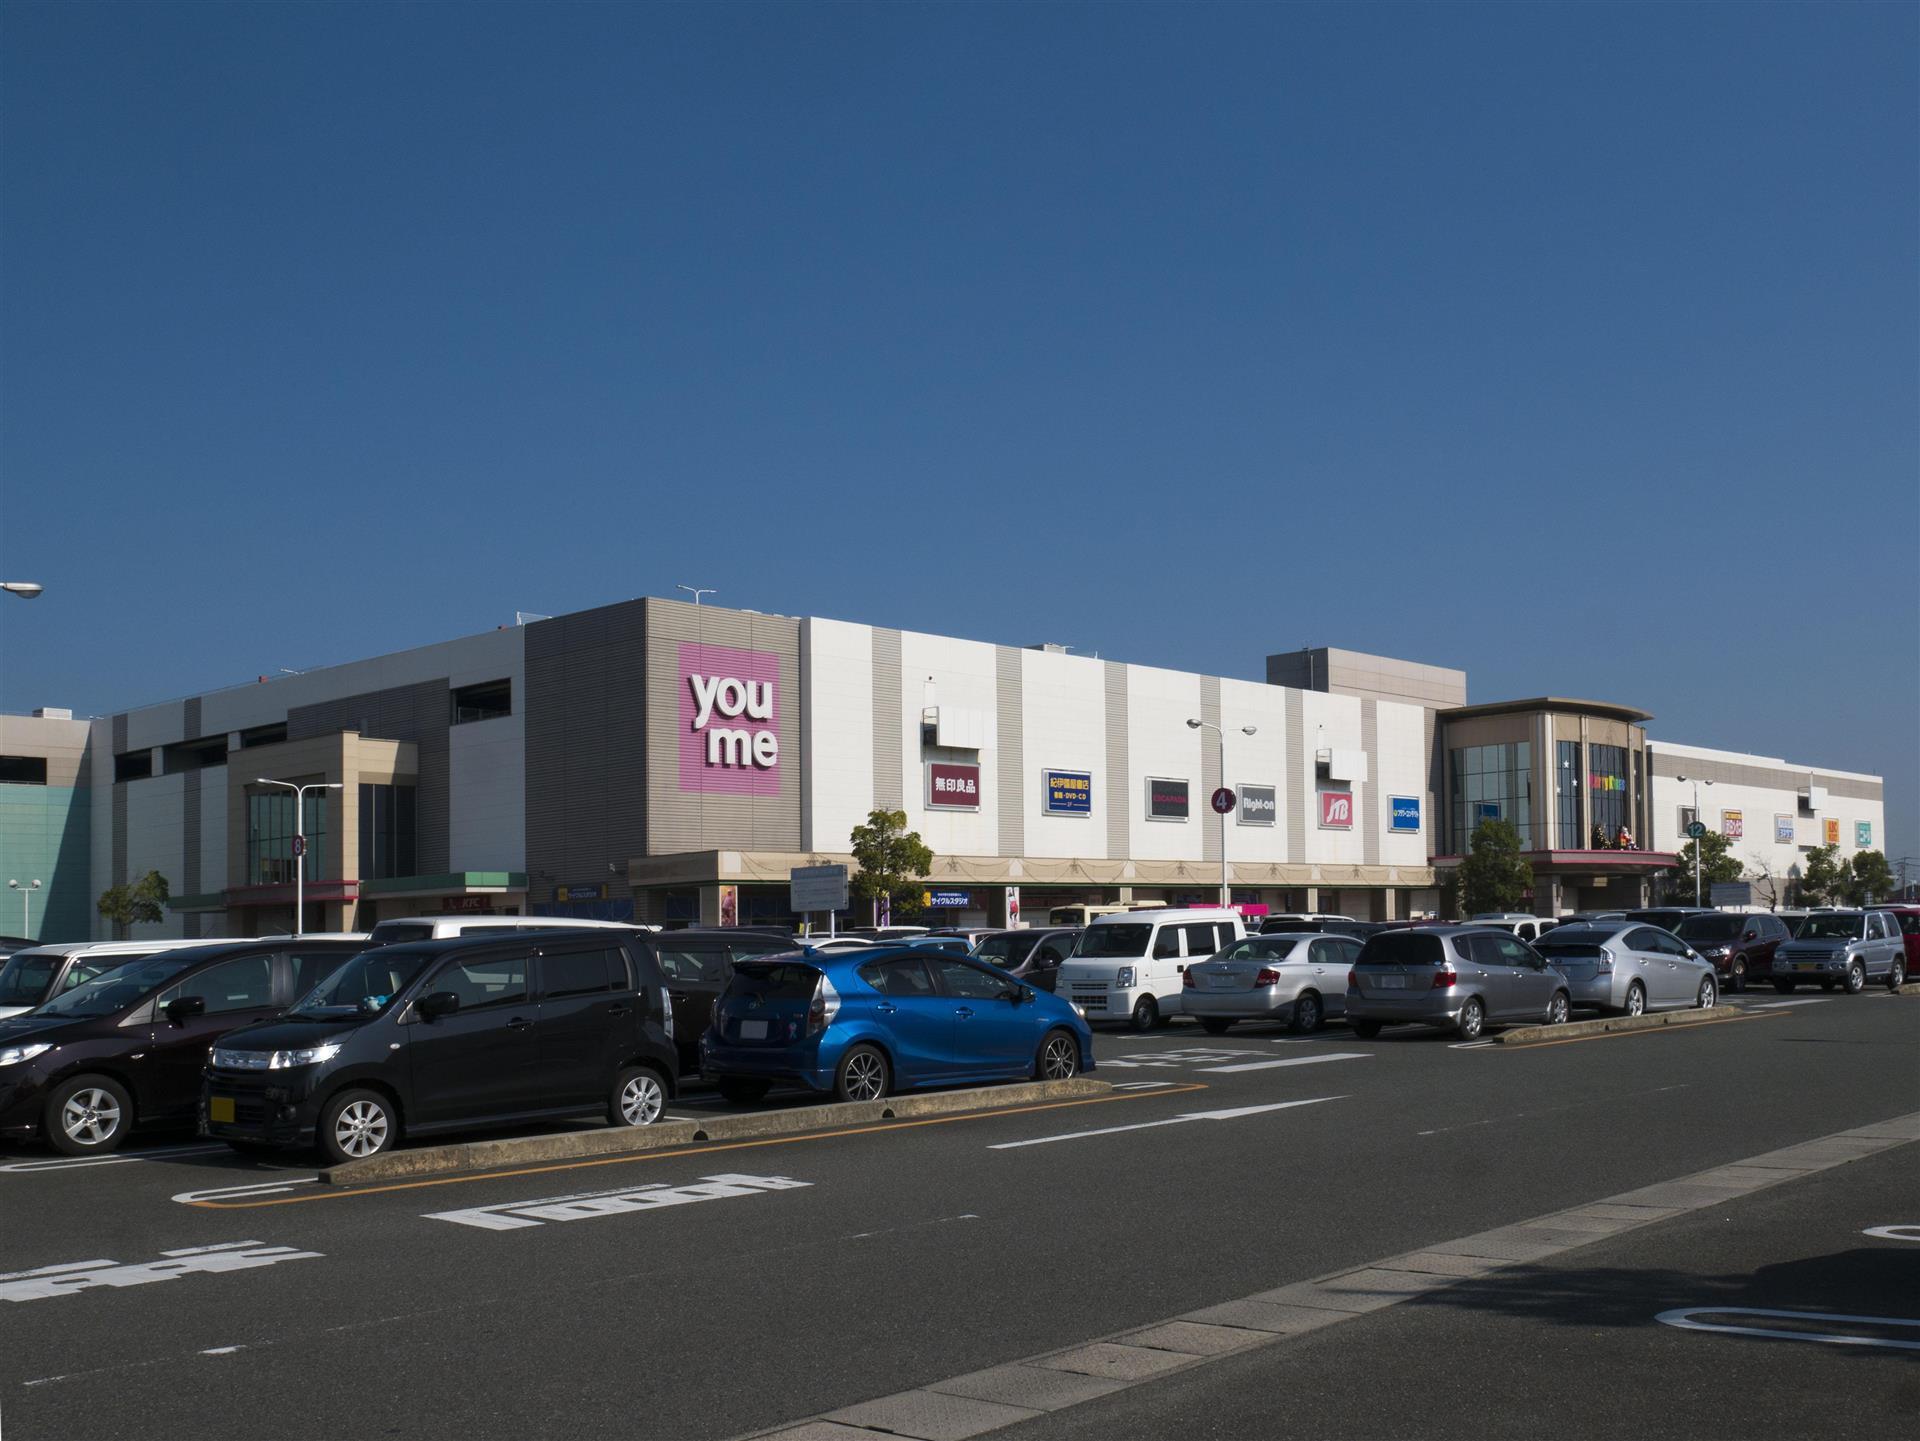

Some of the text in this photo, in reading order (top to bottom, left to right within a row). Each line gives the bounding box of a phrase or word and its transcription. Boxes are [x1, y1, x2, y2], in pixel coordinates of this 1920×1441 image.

[690, 673, 773, 729] you
[708, 728, 779, 767] me
[935, 776, 976, 794] 無印良品
[1216, 791, 1228, 810] 4
[1326, 798, 1349, 823] JTB
[1688, 824, 1703, 837] 12
[295, 838, 301, 854] 8
